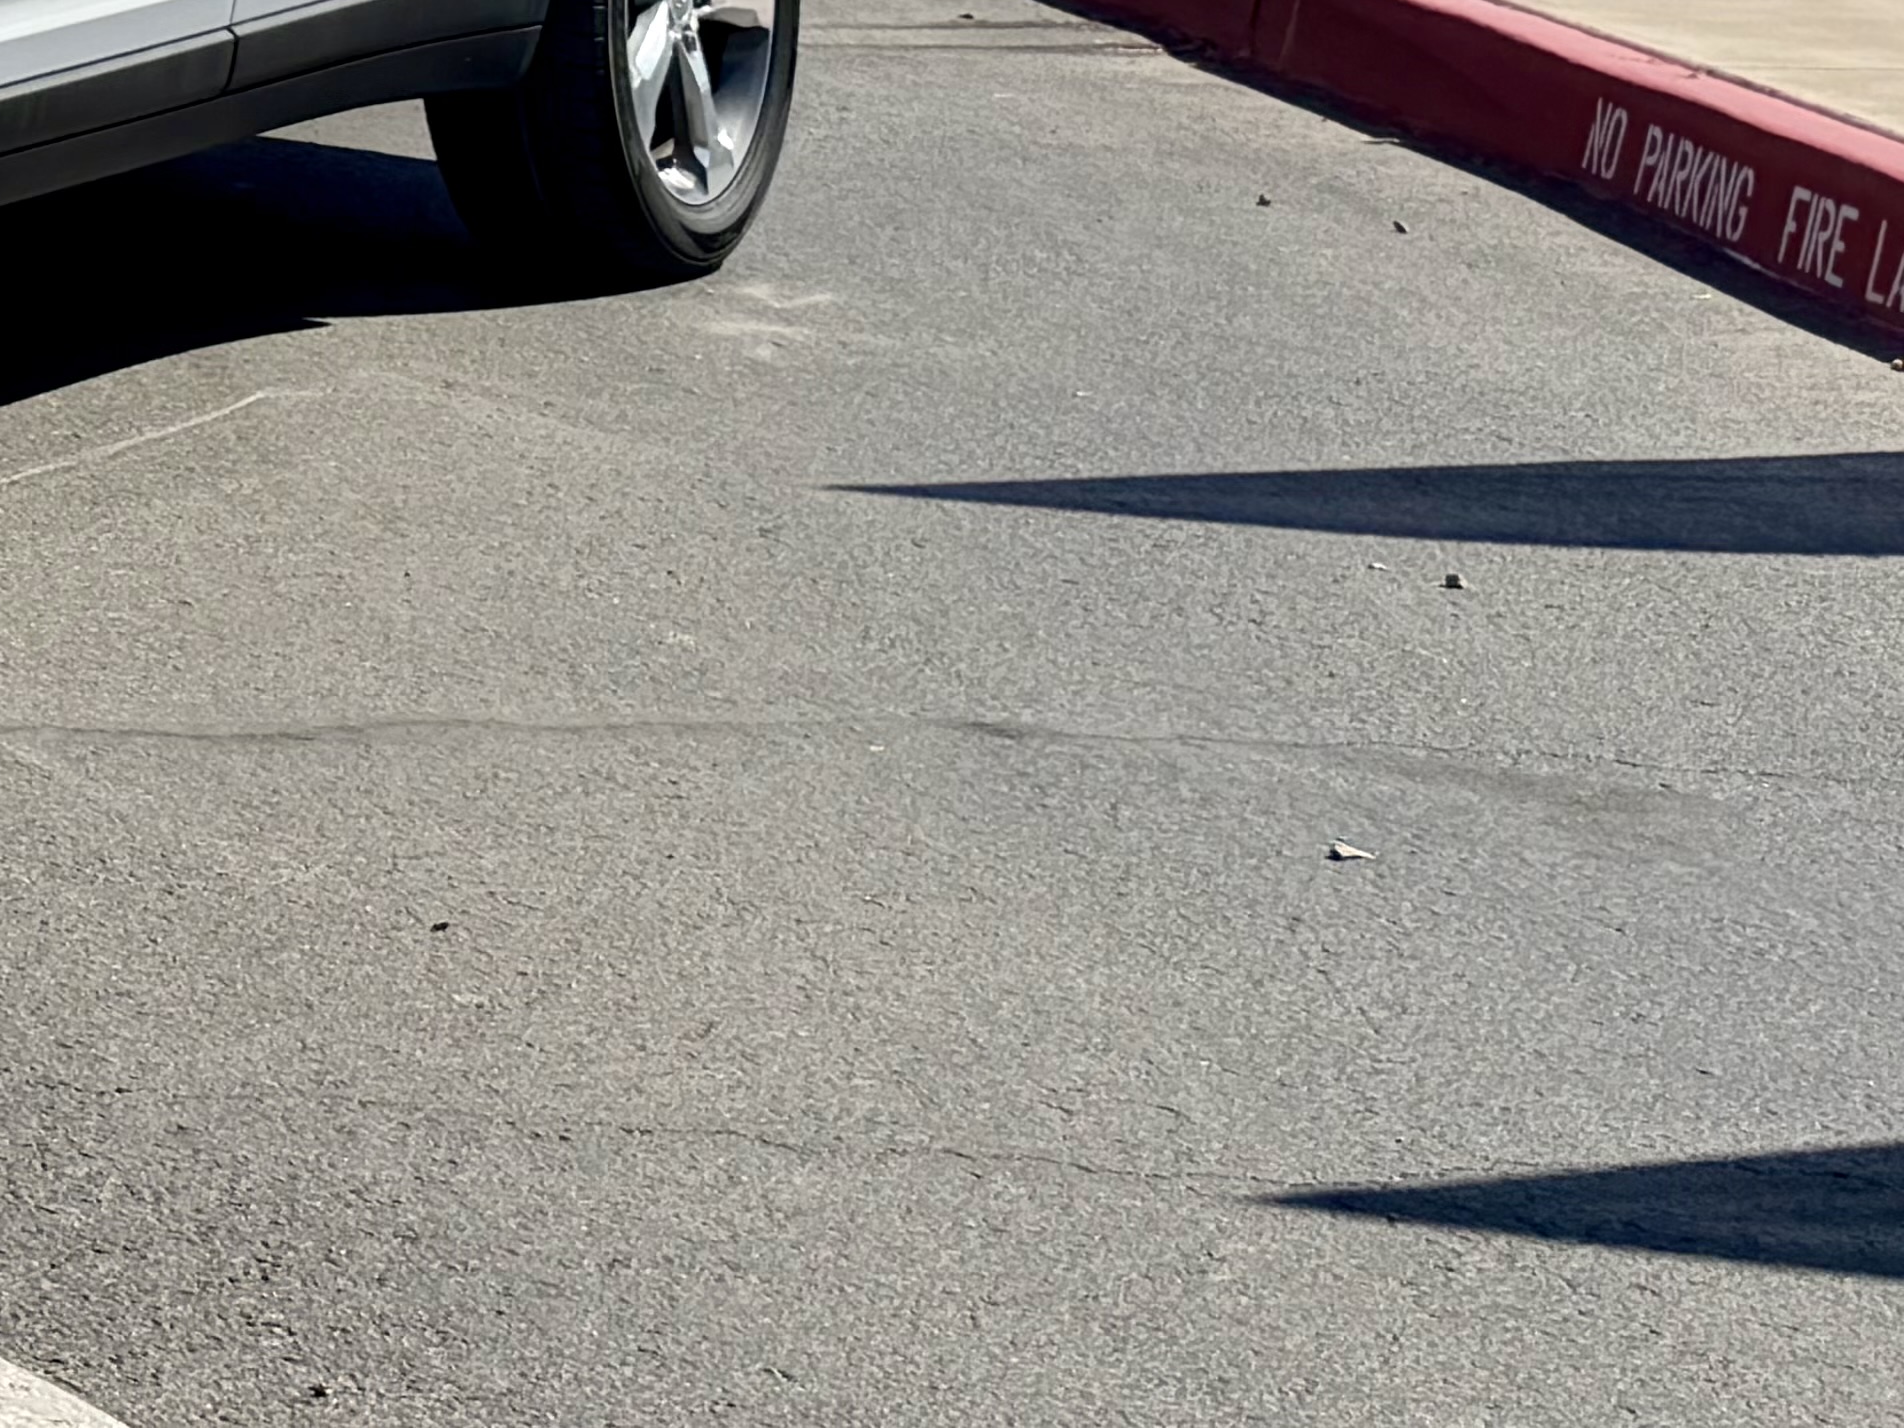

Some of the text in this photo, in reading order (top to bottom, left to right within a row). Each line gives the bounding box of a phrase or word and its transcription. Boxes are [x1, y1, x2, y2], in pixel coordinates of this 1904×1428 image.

[1581, 97, 1628, 180] NO
[1634, 124, 1755, 242] PARKING
[1777, 185, 1860, 288] FIRE
